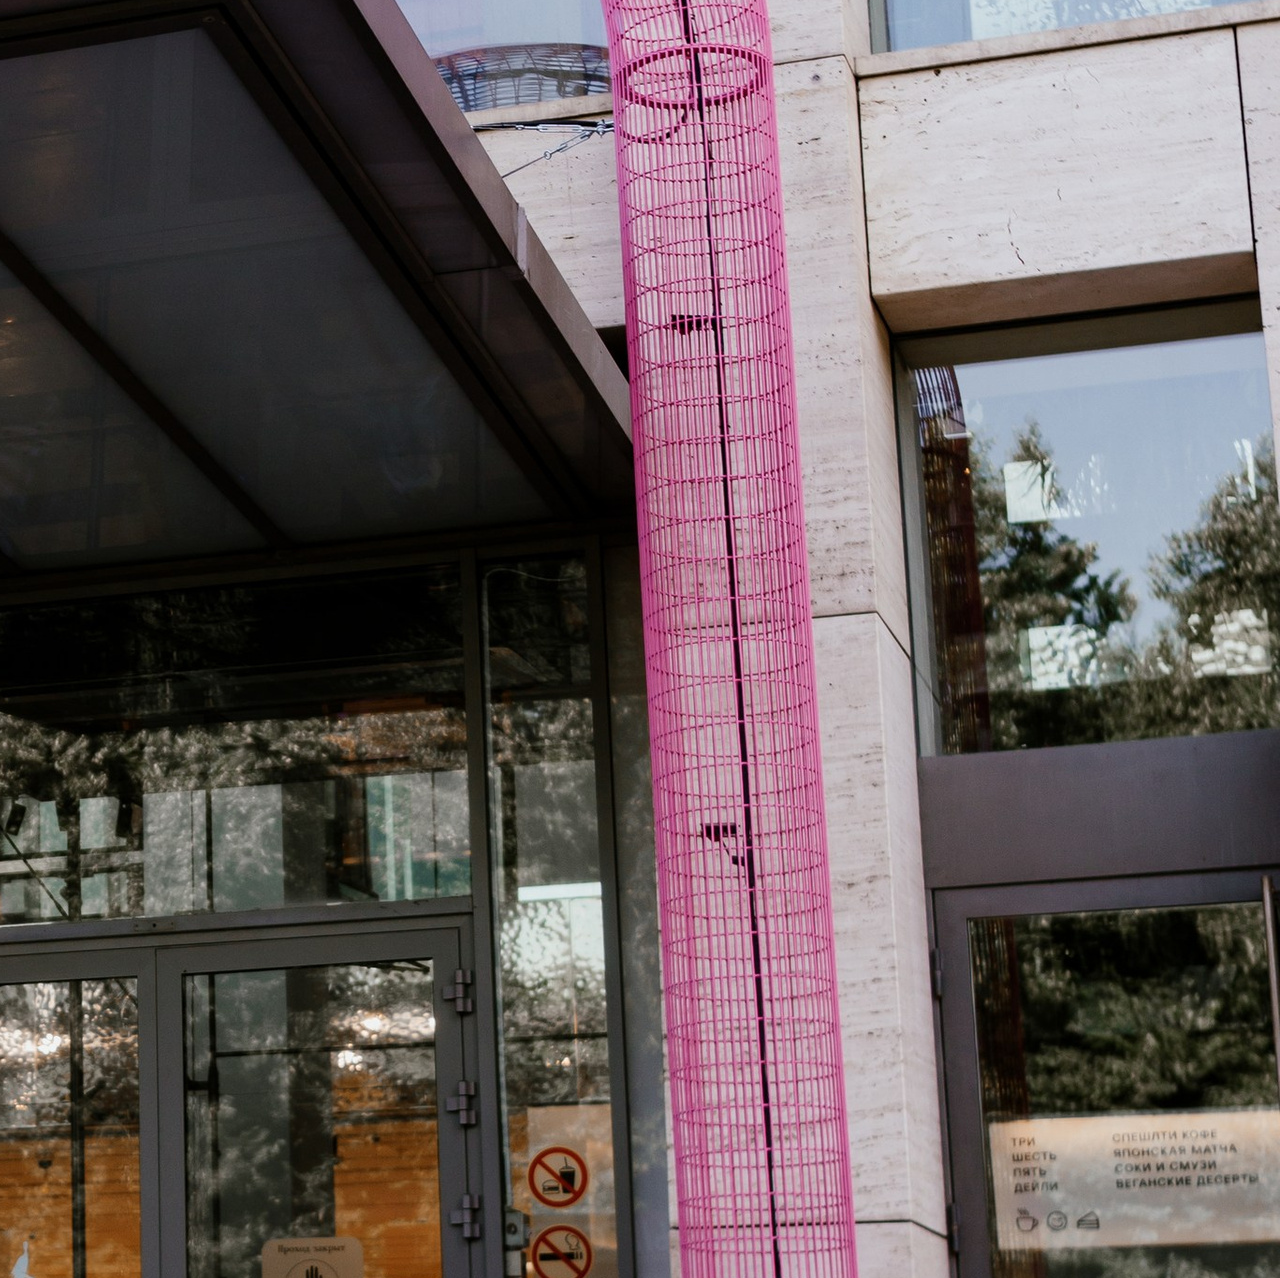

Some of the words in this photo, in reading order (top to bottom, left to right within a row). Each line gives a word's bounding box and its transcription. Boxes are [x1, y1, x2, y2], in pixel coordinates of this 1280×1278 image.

[1182, 1129, 1218, 1141] КОФЕ
[1011, 1137, 1036, 1146] ТРИ
[1012, 1151, 1057, 1162] ШЕСТЬ
[1113, 1144, 1186, 1158] ЯПОНСКАЯ
[1191, 1143, 1237, 1155] МАТЧА
[1013, 1166, 1047, 1177] ПЯТЬ
[1114, 1162, 1152, 1174] СОКИ
[1156, 1162, 1165, 1172] И
[1170, 1160, 1217, 1171] СМУЗИ
[1116, 1175, 1192, 1189] ВЕГАНСКИЕ
[1196, 1173, 1259, 1187] ДЕСЕРТЫ
[1014, 1181, 1058, 1194] ДЕЙЛИ
